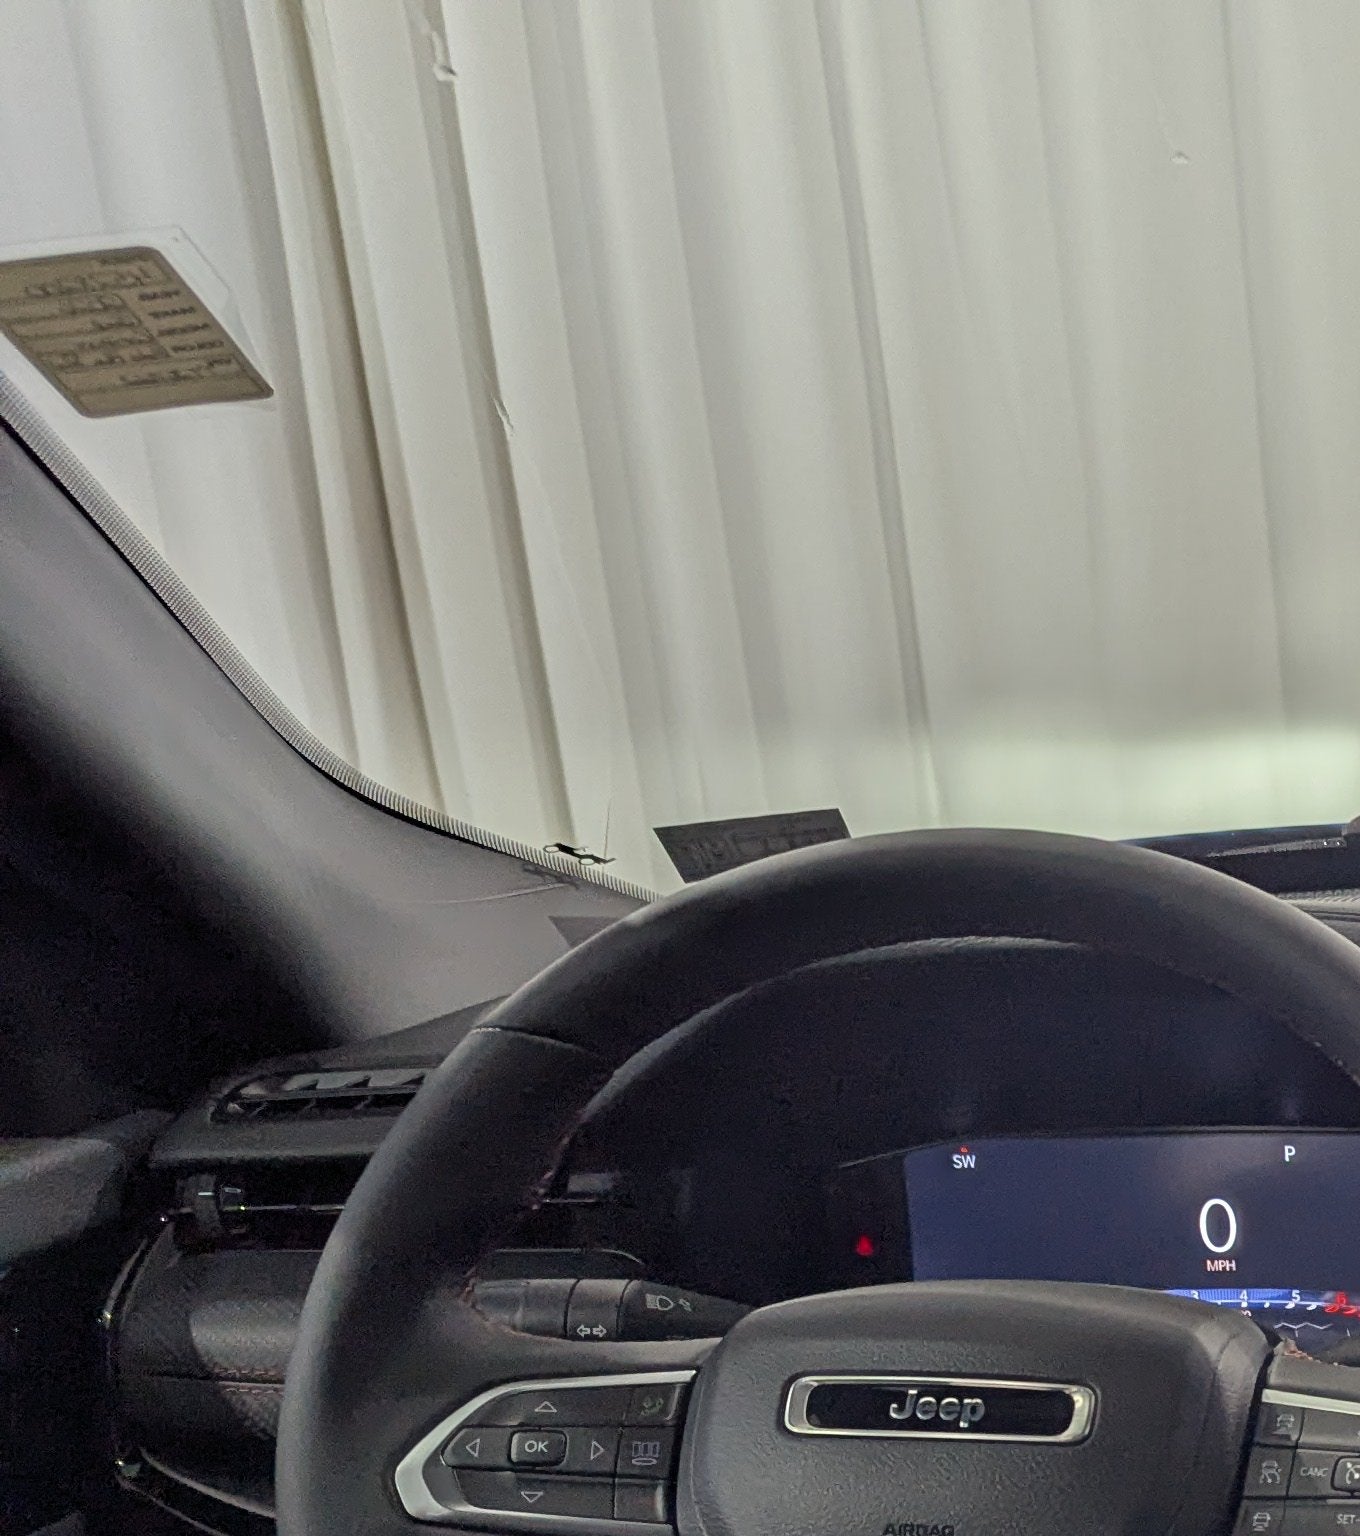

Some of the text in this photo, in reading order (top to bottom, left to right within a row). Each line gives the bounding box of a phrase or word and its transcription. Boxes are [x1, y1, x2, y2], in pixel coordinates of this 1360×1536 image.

[1284, 1145, 1296, 1162] P
[952, 1154, 976, 1169] SW
[1199, 1198, 1237, 1253] 0
[1206, 1259, 1236, 1272] MPH
[1291, 1290, 1301, 1302] 5
[889, 1389, 985, 1428] Jeep
[524, 1440, 549, 1453] OK
[1300, 1467, 1328, 1477] CANC
